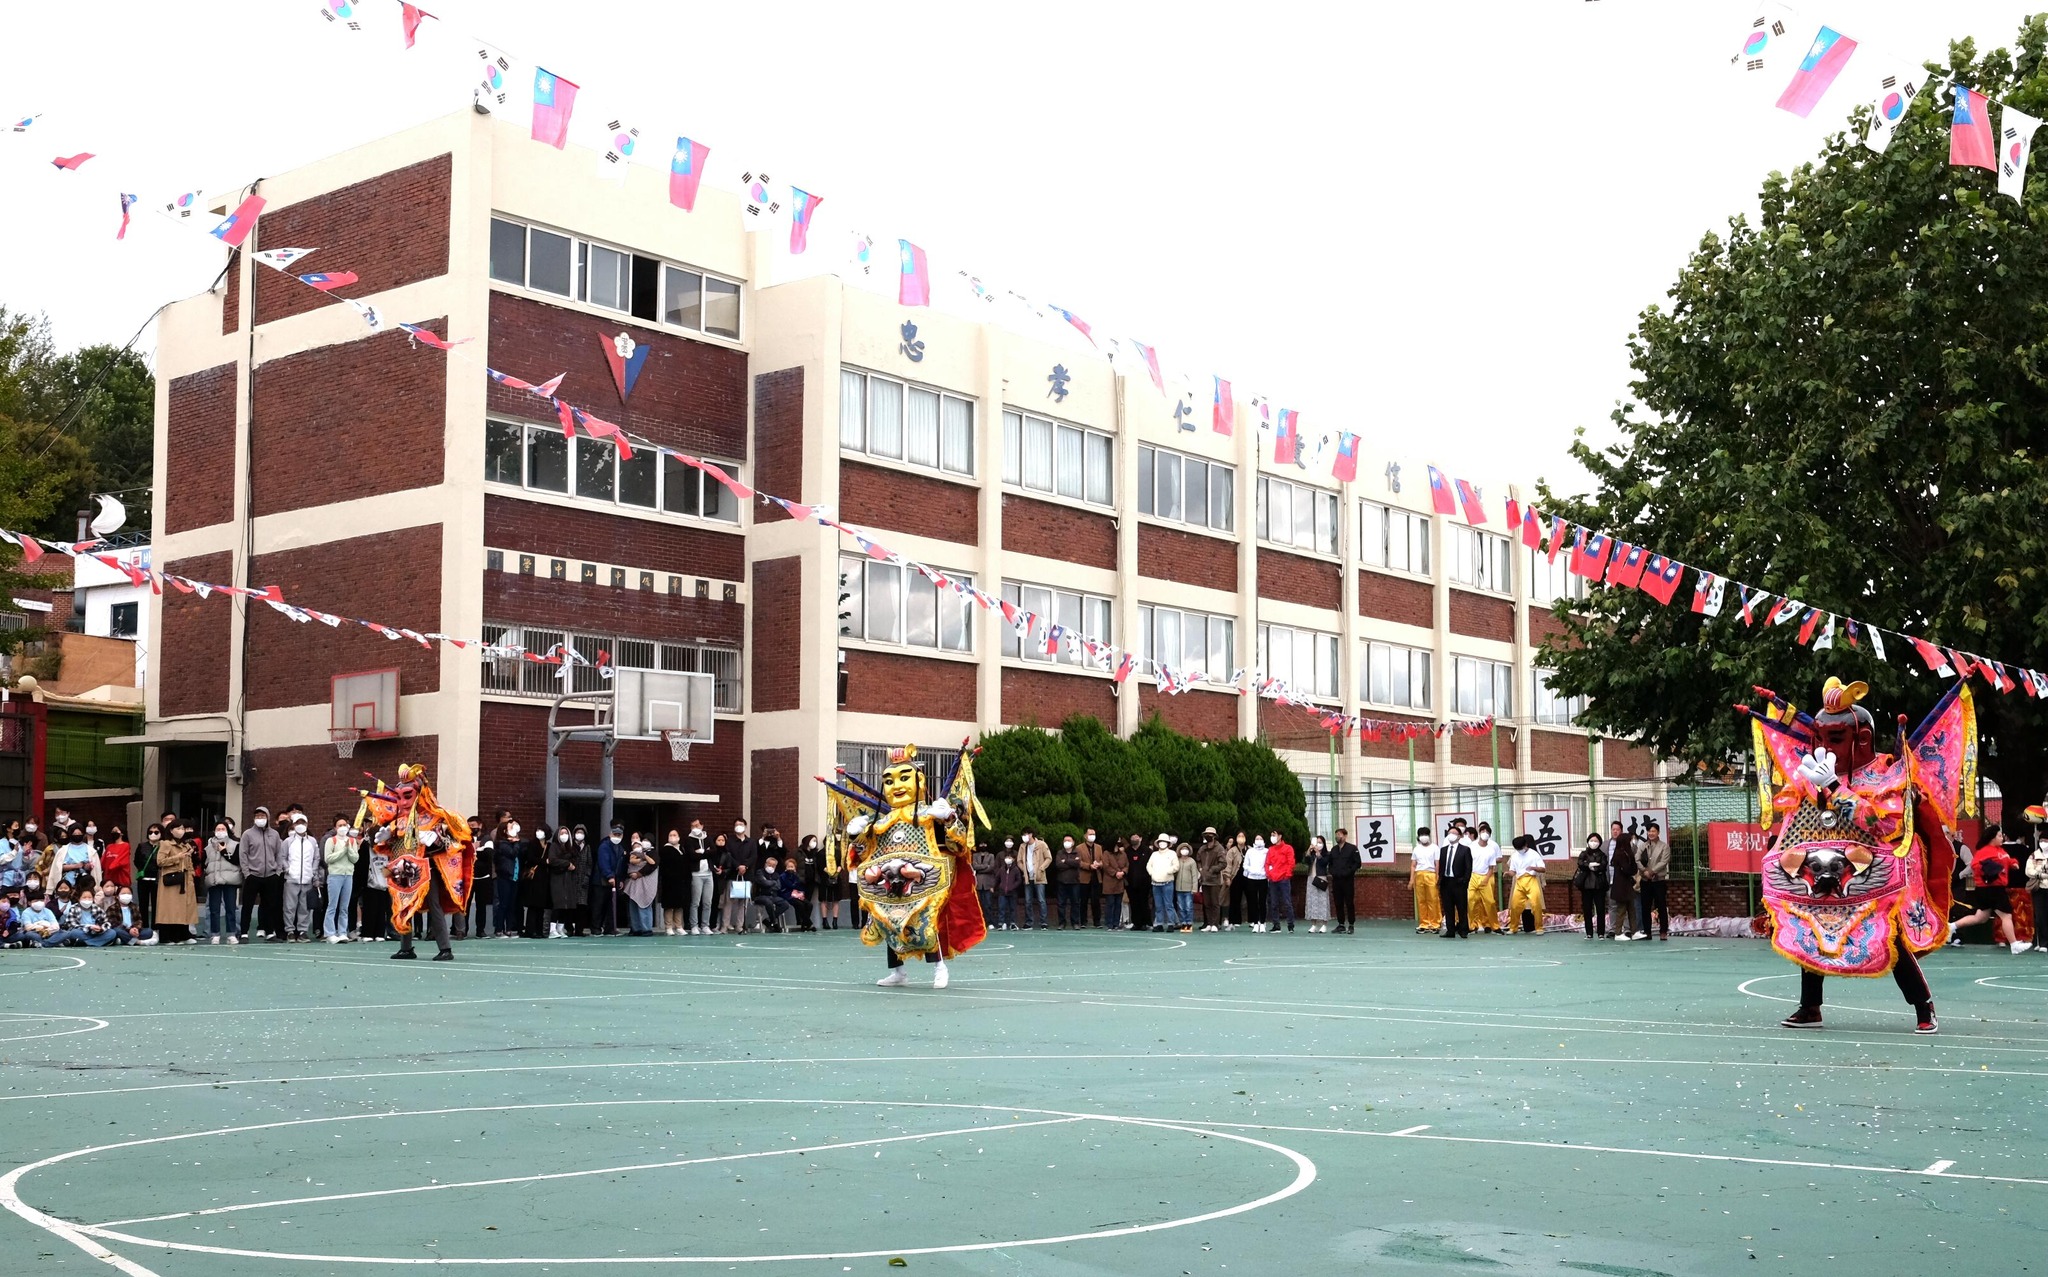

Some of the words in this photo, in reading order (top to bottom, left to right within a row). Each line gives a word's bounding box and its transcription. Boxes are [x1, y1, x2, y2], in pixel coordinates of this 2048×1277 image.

[898, 319, 925, 363] 忠
[1047, 363, 1072, 404] 孝
[1173, 399, 1197, 434] 仁
[1384, 460, 1401, 494] 信
[1362, 820, 1389, 859] 吾
[1535, 814, 1563, 857] 吾
[1801, 829, 1860, 840] TAIWAN
